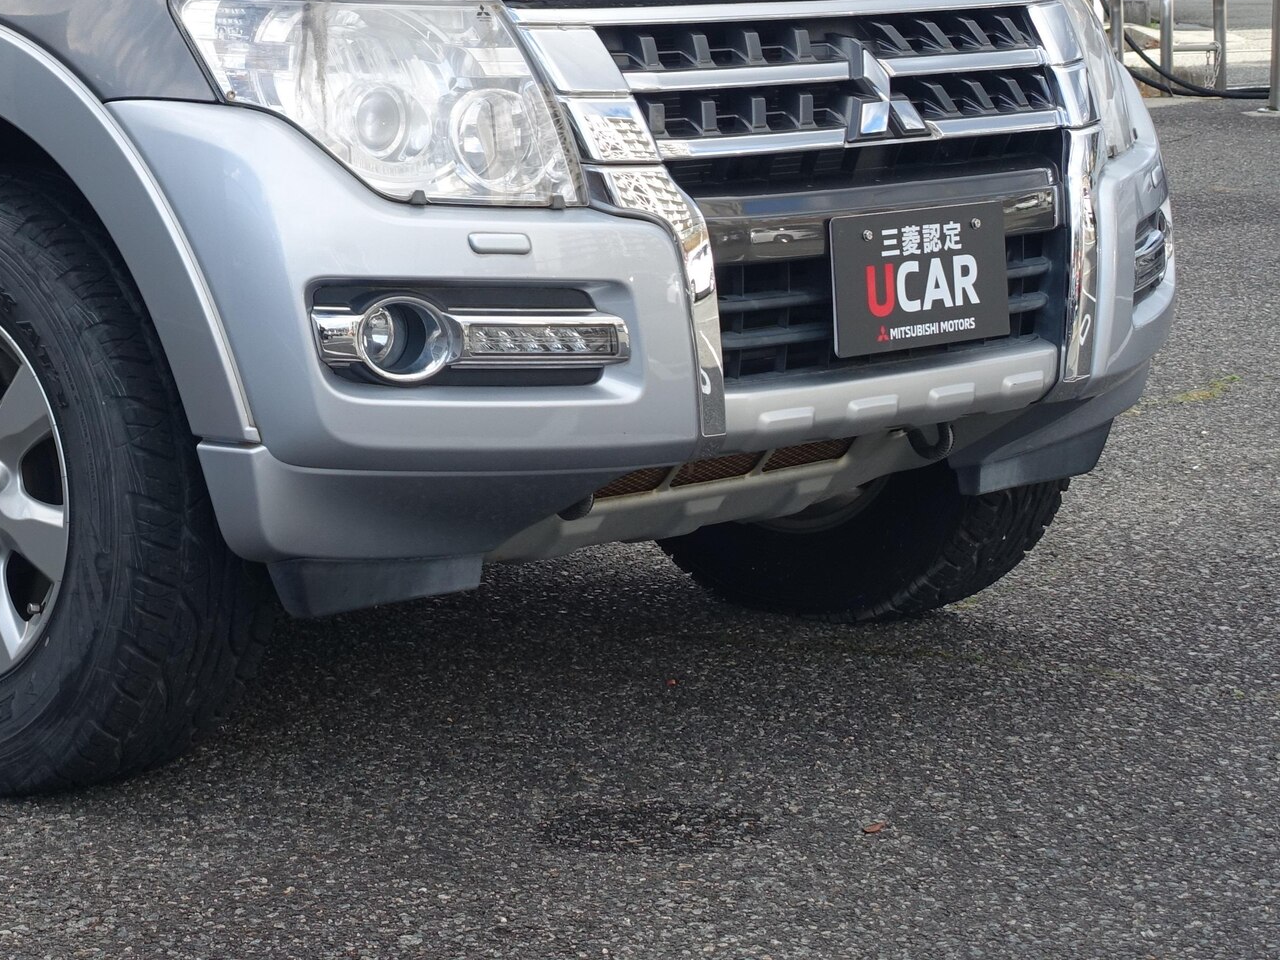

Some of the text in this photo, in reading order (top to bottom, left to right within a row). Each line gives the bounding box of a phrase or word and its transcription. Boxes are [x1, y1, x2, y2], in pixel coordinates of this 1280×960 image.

[881, 221, 962, 257] 三菱認定
[866, 254, 981, 318] UCAR
[889, 317, 976, 341] MITSUBISHI MOTORS
